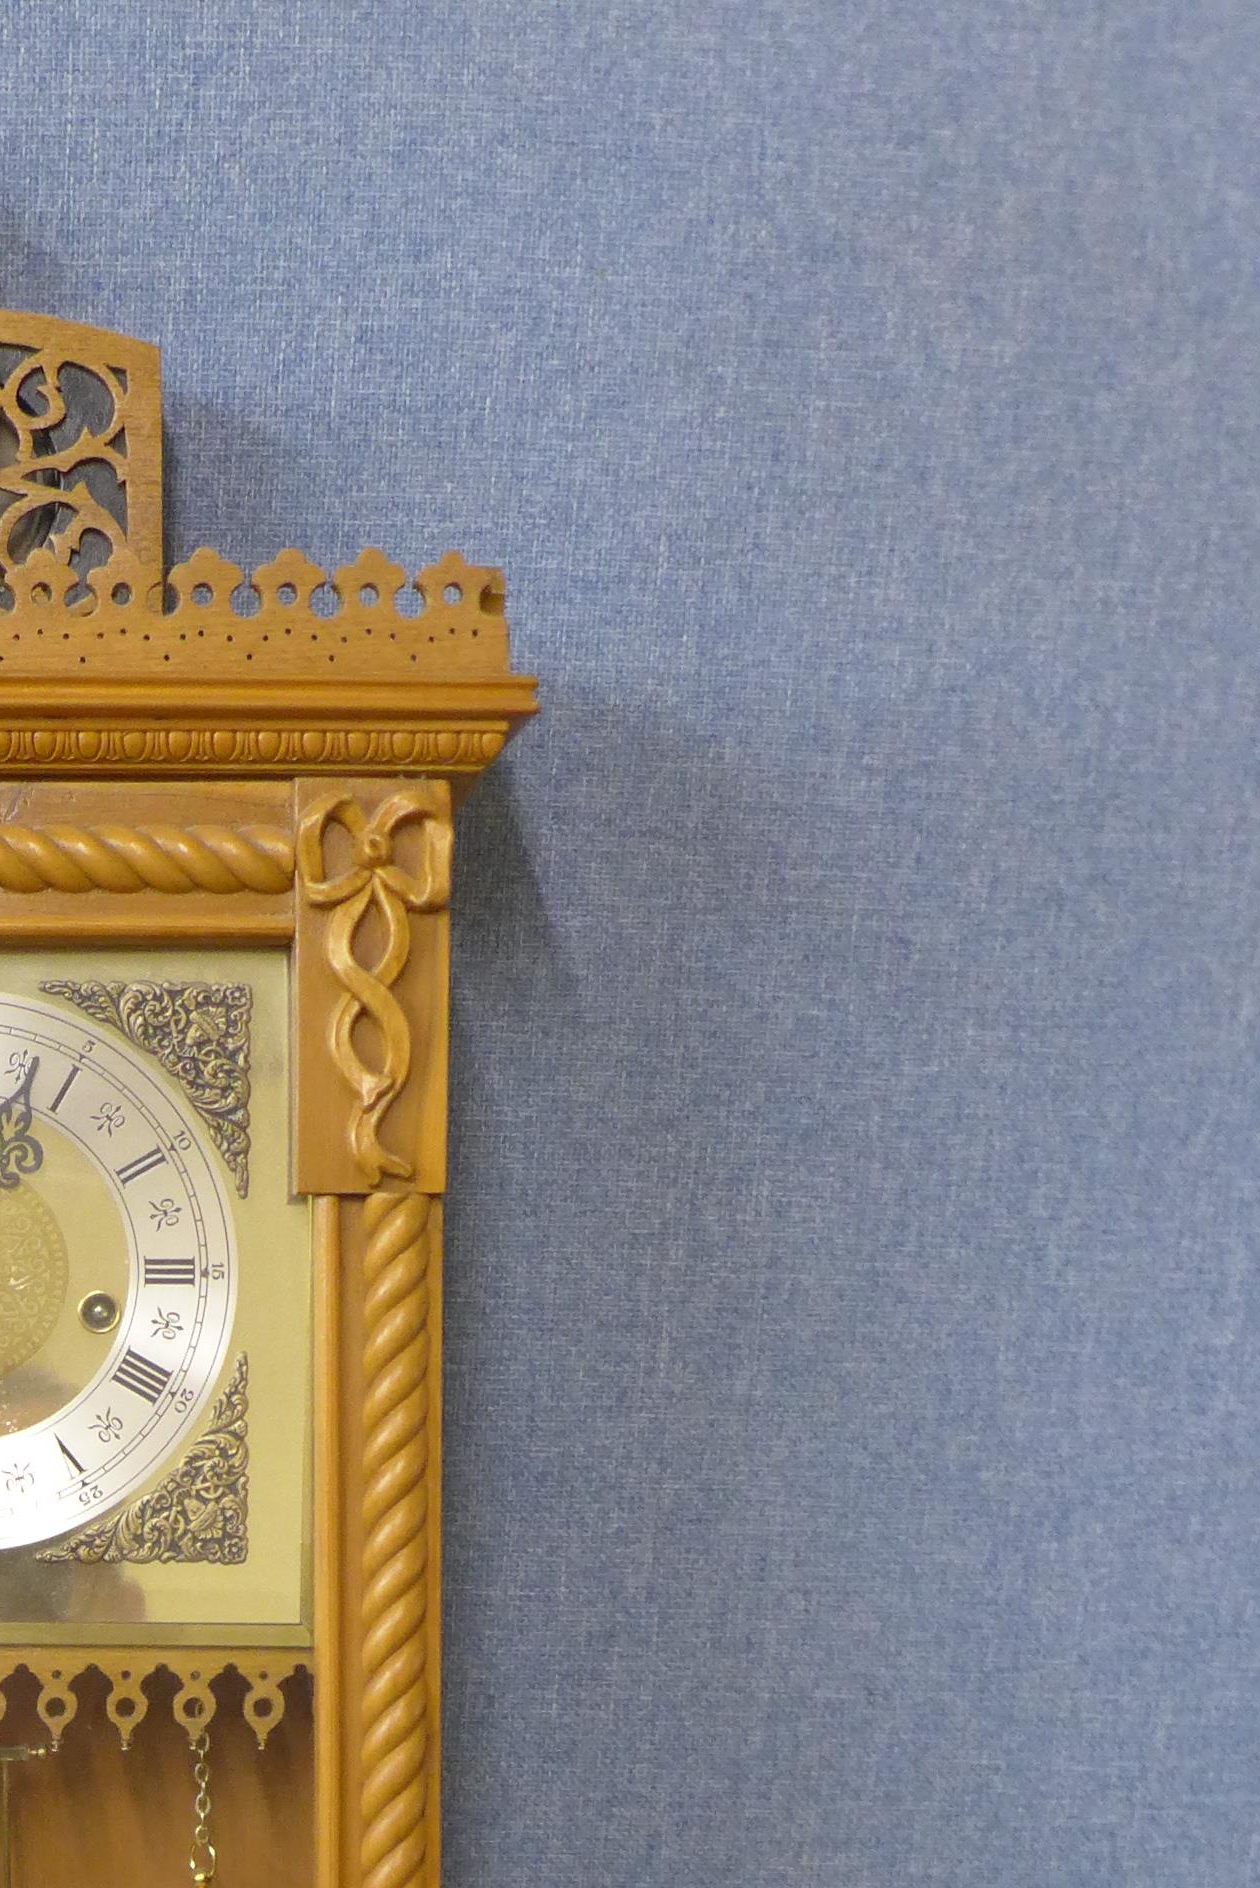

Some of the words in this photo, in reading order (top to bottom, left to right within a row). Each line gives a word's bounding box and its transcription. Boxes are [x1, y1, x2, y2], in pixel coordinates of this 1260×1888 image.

[82, 1040, 96, 1054] 5
[47, 1063, 82, 1116] I
[172, 1130, 192, 1152] 10
[113, 1143, 170, 1189] II
[143, 1255, 196, 1288] III
[211, 1261, 226, 1281] 15
[110, 1345, 175, 1407] IIII
[174, 1388, 195, 1414] 20
[53, 1431, 88, 1481] V
[78, 1484, 104, 1507] 25
